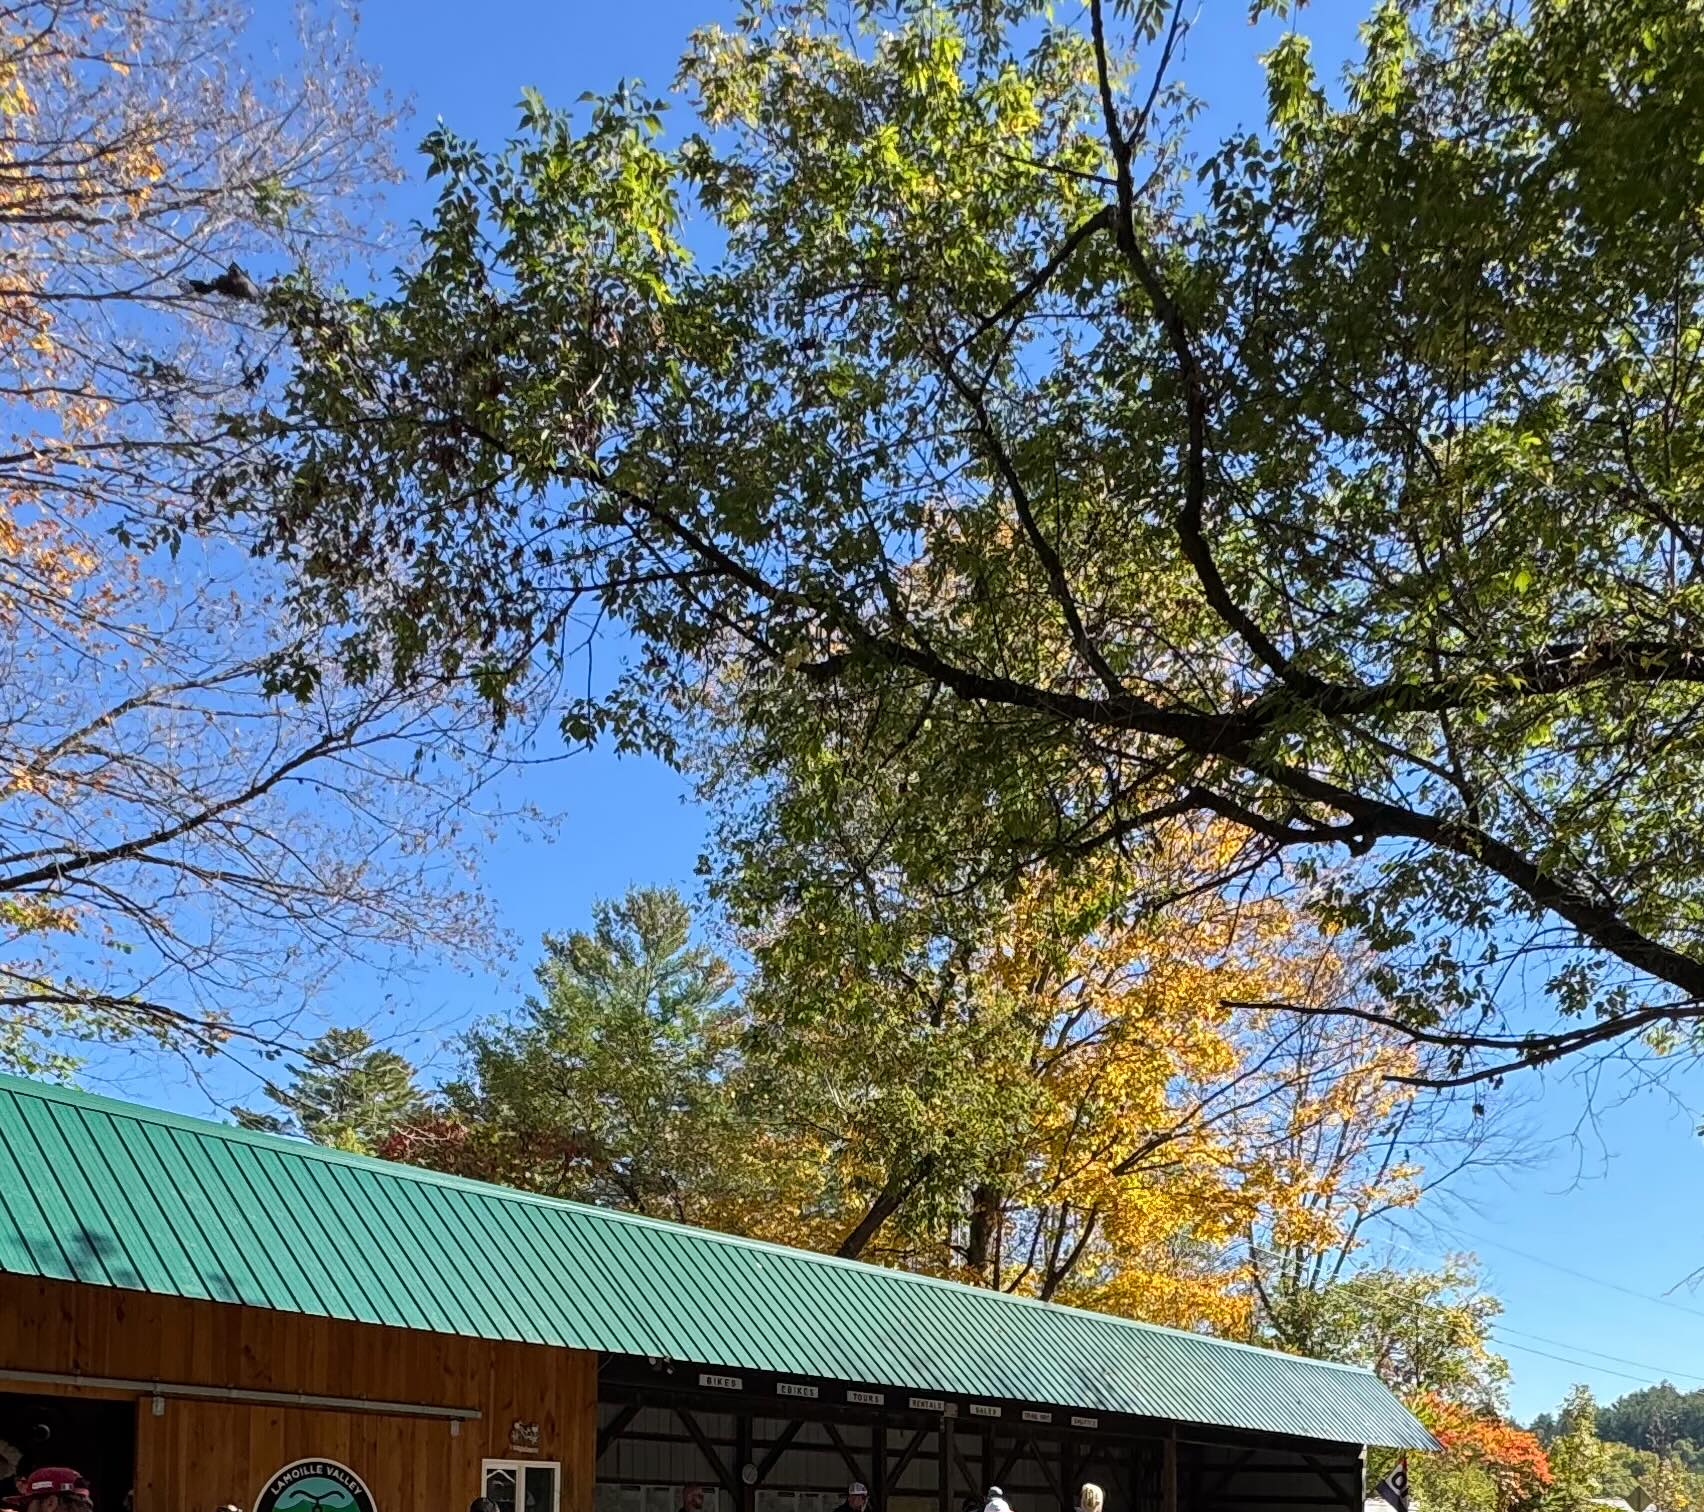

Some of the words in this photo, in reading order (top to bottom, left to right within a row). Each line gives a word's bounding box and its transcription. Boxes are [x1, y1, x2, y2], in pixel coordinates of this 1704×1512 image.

[705, 1376, 737, 1388] BIKES
[780, 1384, 815, 1397] EBIKES
[852, 1392, 880, 1403] TOURS
[911, 1399, 943, 1410] RENTALS
[975, 1406, 997, 1416] SALES
[271, 1464, 324, 1496] LAMOILLE
[326, 1466, 362, 1495] VALLEY
